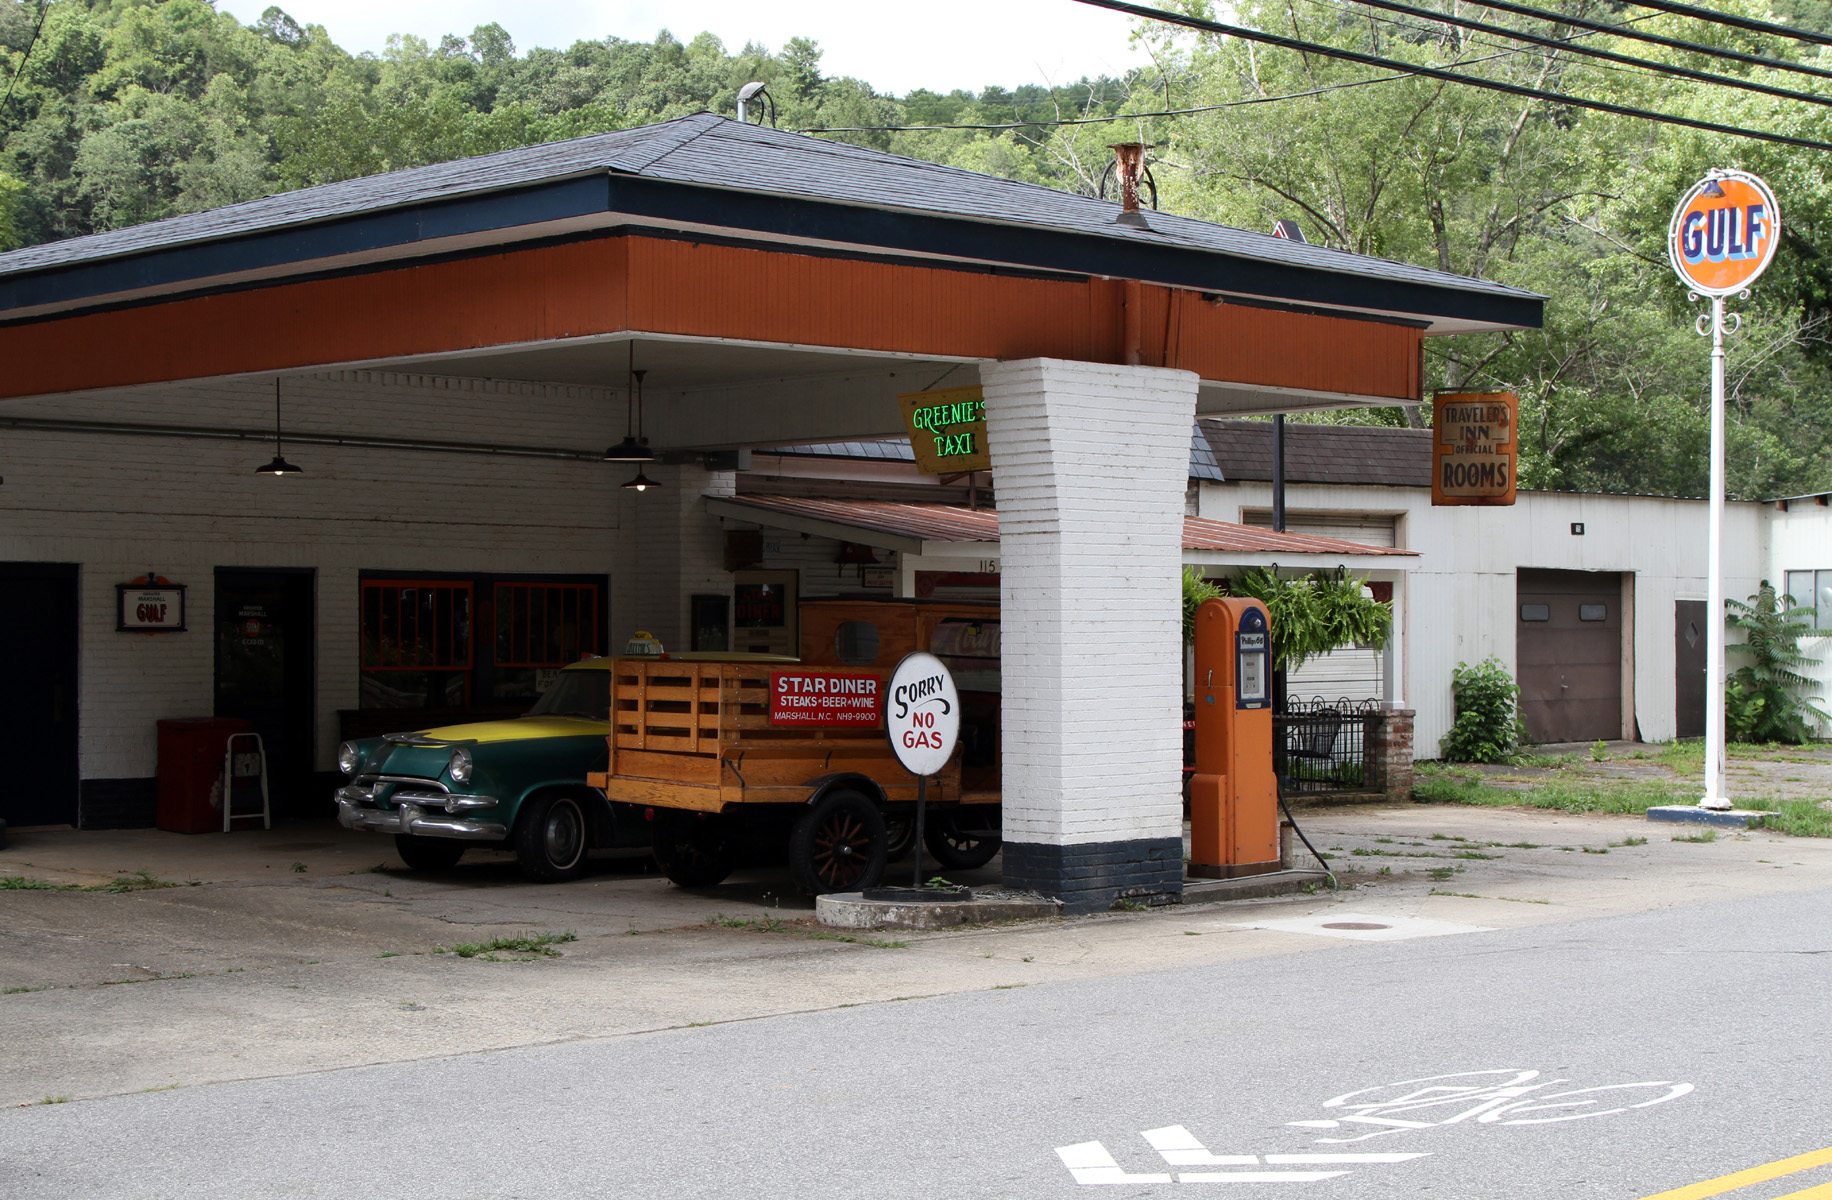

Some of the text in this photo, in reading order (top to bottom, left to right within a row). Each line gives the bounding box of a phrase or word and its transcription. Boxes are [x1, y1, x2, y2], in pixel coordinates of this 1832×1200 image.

[1681, 204, 1768, 265] GULF
[1445, 406, 1508, 423] TRAVELER'S
[1459, 425, 1490, 440] INN
[933, 433, 971, 456] TAXI
[1455, 444, 1494, 455] OFFICIAL
[1443, 462, 1507, 488] ROOMS
[979, 559, 996, 574] 115
[136, 603, 167, 623] GULF
[737, 603, 780, 619] DINER
[777, 676, 877, 694] STAR DINER
[895, 674, 944, 719] SORRY
[836, 712, 876, 721] NH9-9900
[912, 711, 935, 729] NO
[902, 730, 943, 750] GAS
